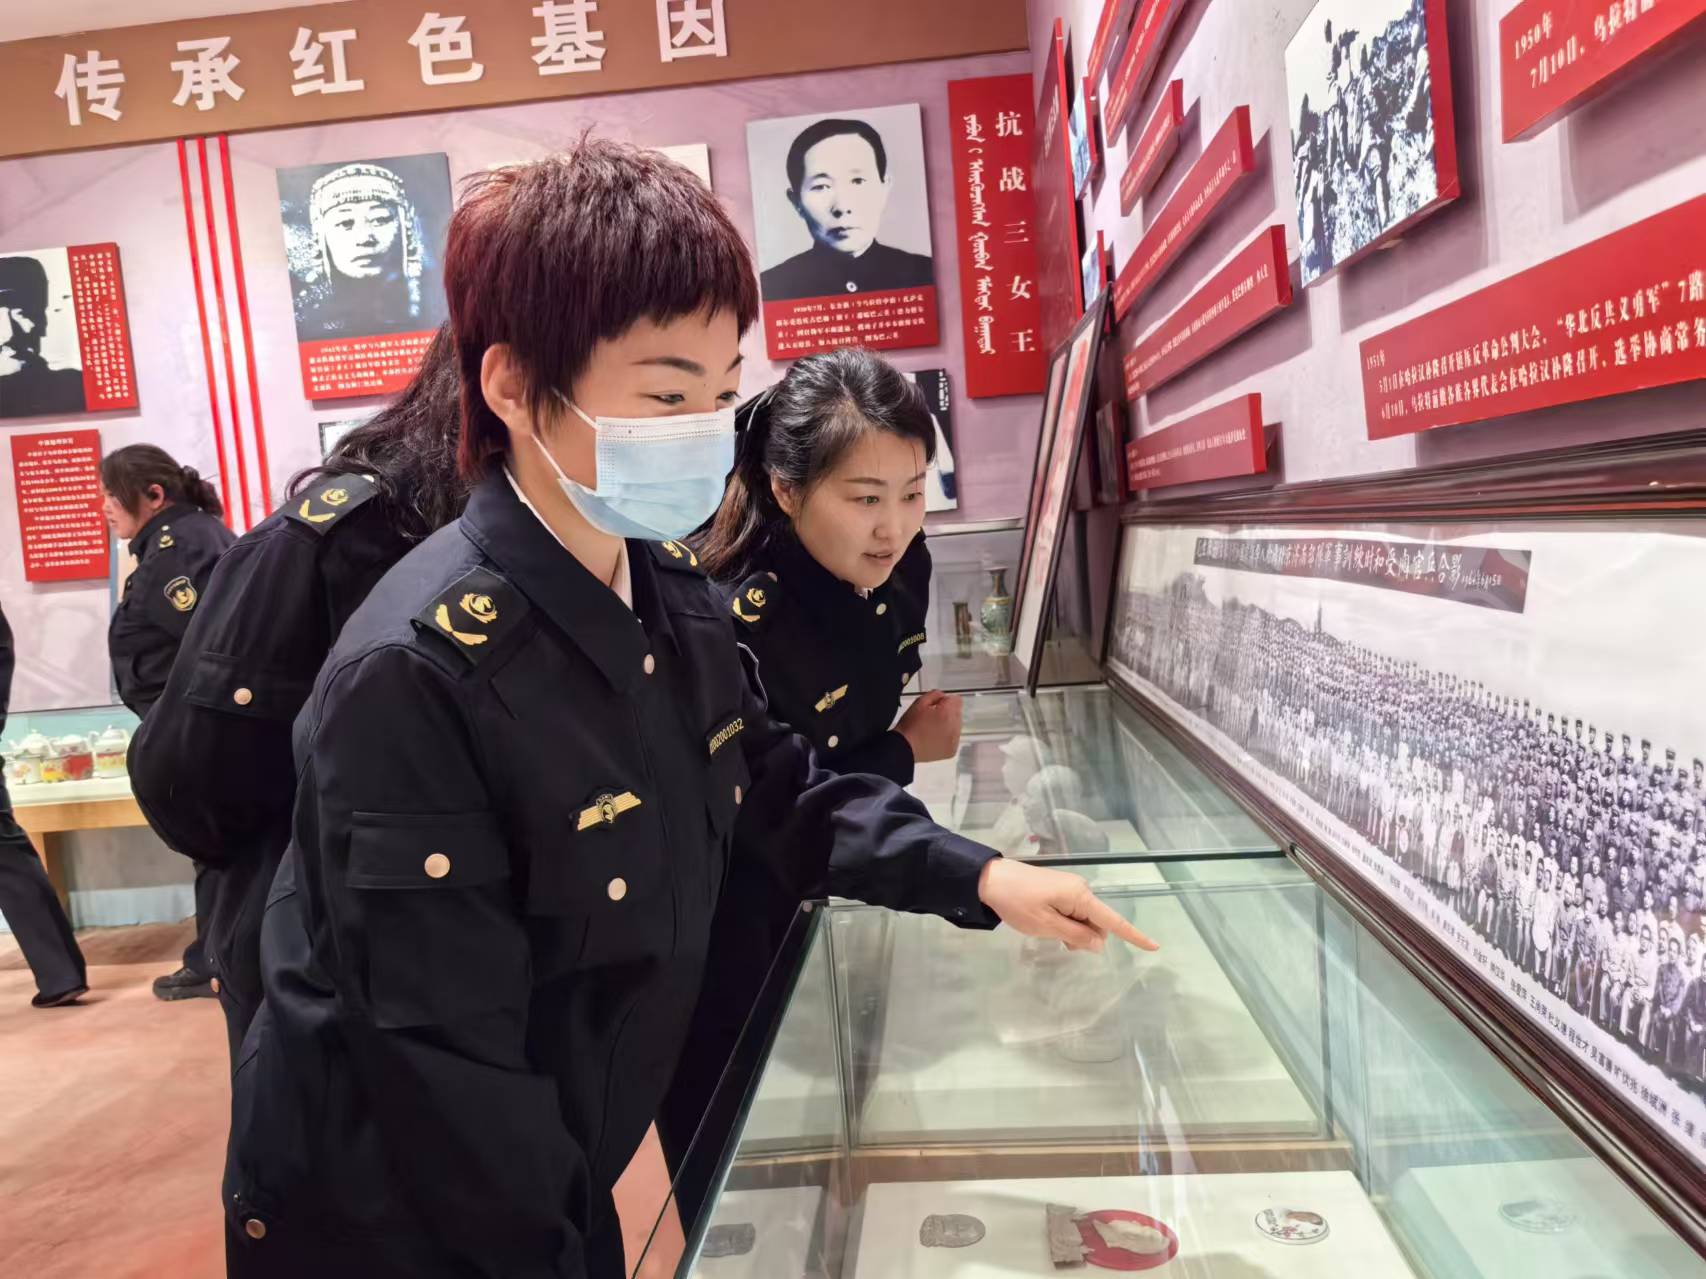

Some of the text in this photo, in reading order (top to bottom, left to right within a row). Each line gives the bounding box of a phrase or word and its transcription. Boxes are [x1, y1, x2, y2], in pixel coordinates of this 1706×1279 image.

[54, 0, 729, 126] 传承红色基因
[1514, 11, 1552, 60] 1950年
[995, 111, 1035, 352] 抗战三女王
